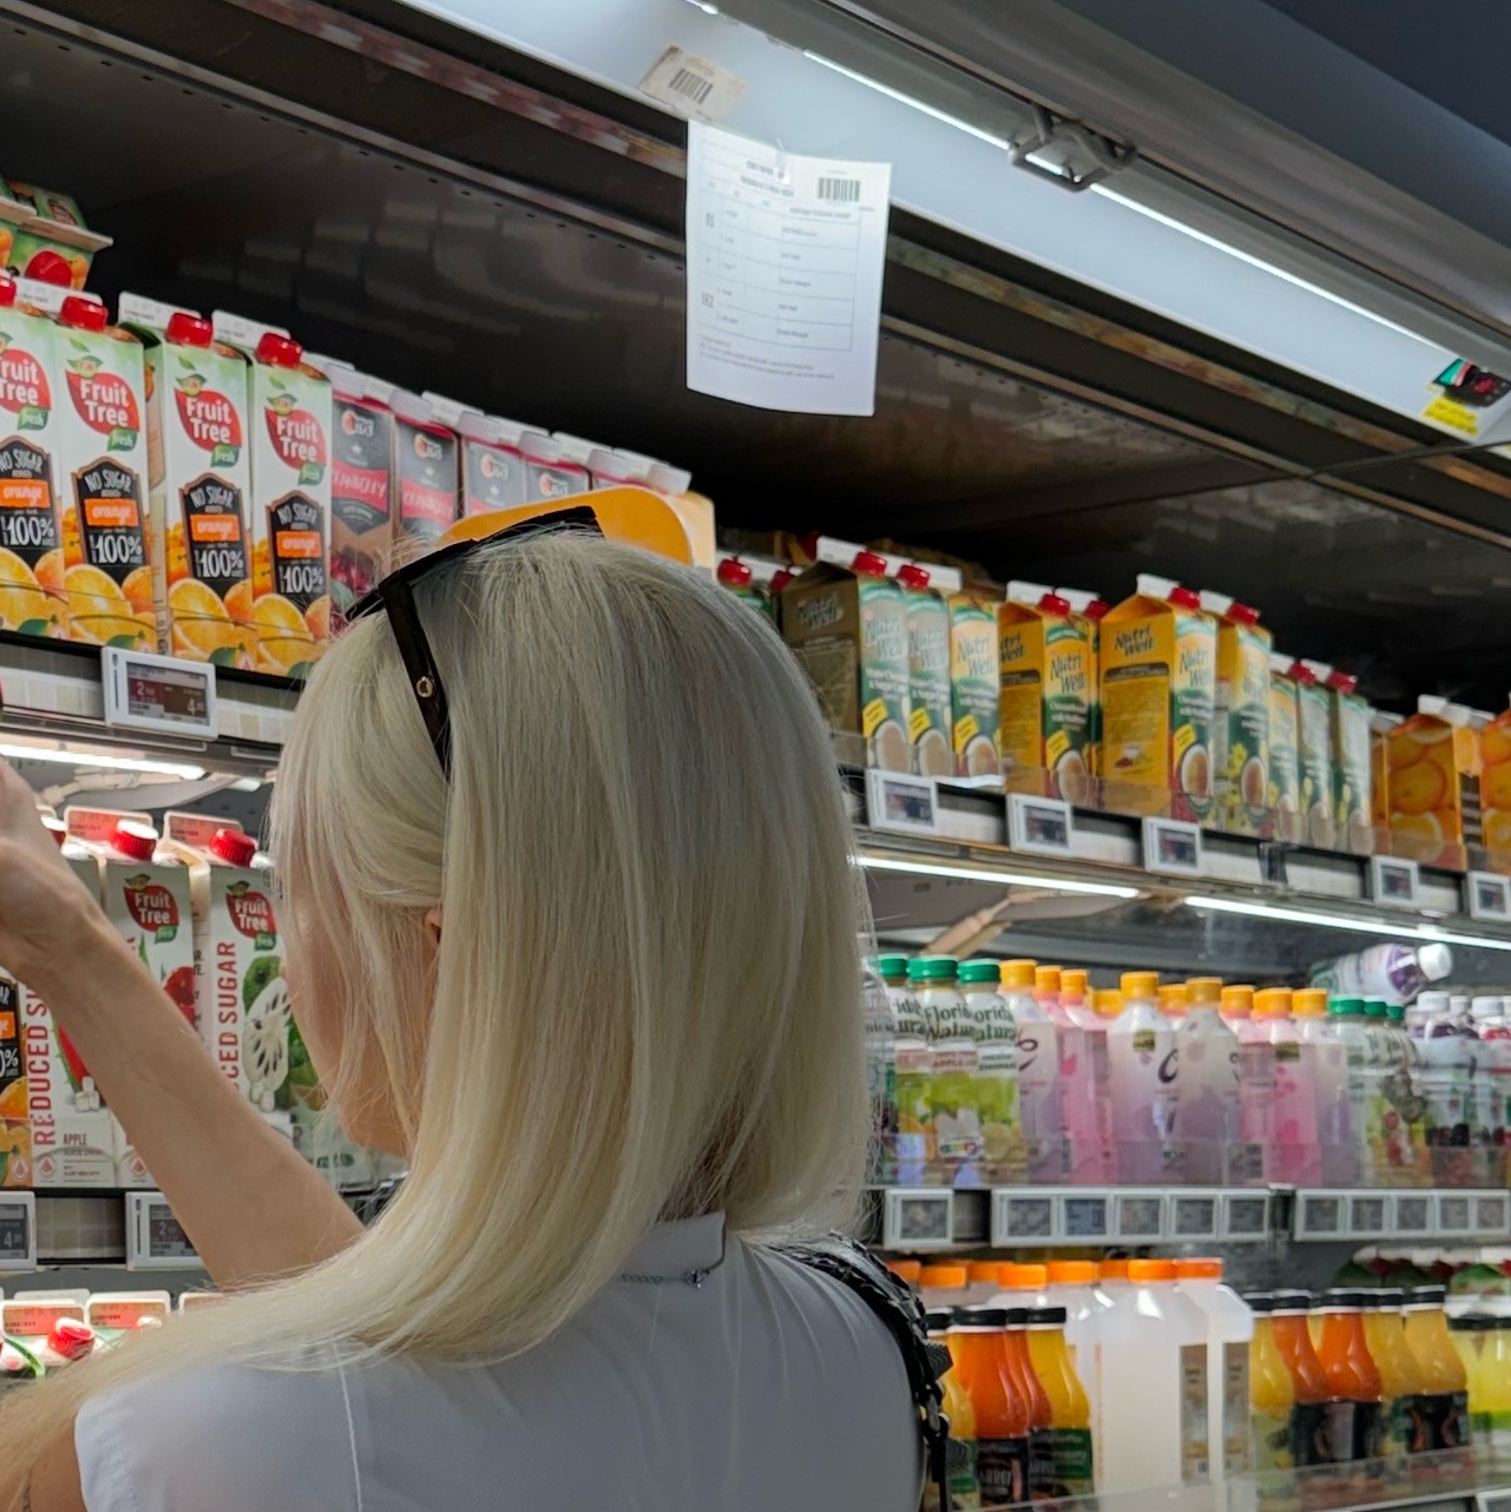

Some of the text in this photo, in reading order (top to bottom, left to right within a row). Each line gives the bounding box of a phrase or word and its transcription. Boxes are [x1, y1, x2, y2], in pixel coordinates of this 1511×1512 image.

[2, 486, 43, 505] orange
[3, 516, 54, 546] 100%
[234, 899, 267, 916] Fruit
[238, 913, 268, 931] Tree
[218, 942, 238, 1022] SUGAR
[26, 1023, 55, 1145] REDUCED
[63, 1133, 87, 1145] APPLE
